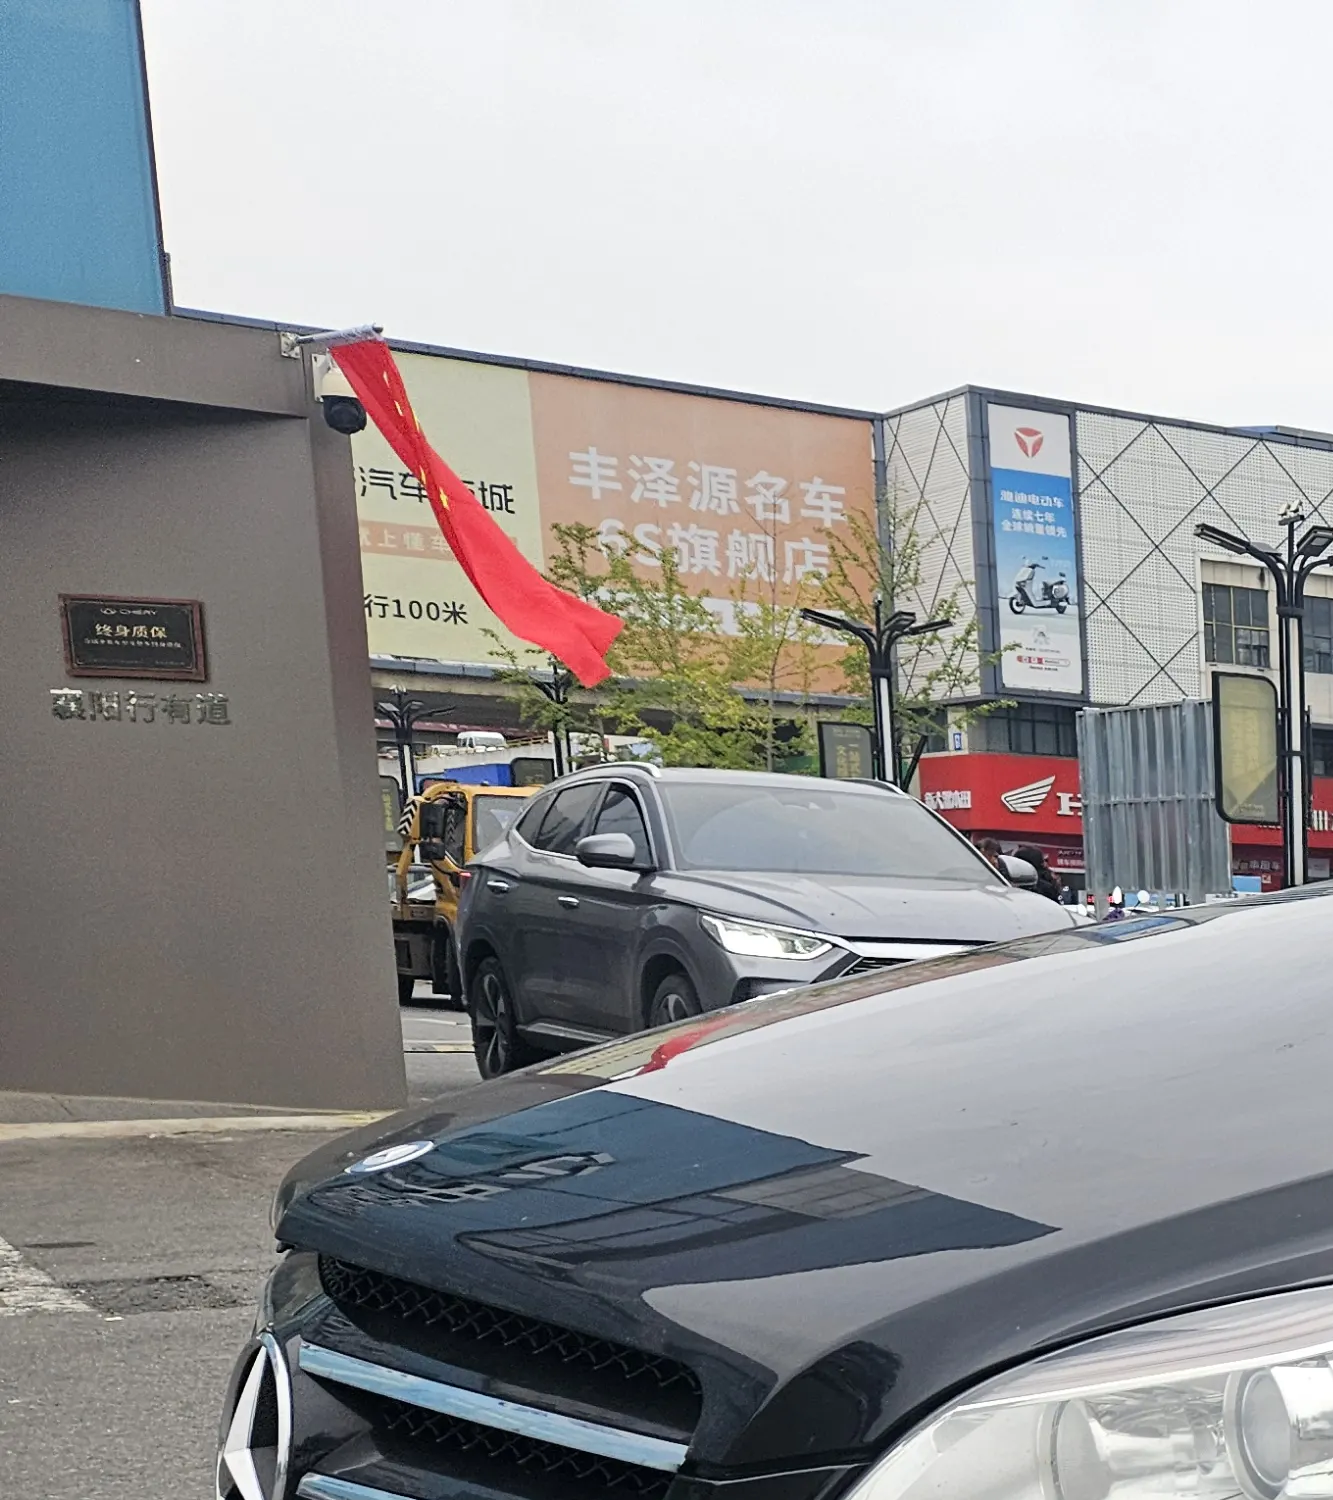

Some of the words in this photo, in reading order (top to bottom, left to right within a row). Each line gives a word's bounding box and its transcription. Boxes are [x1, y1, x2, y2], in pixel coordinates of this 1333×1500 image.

[568, 446, 848, 527] 丰泽源名车
[597, 517, 831, 587] 6S旗舰店
[94, 622, 168, 639] 终身质保
[50, 687, 232, 726] 襄阳行有道
